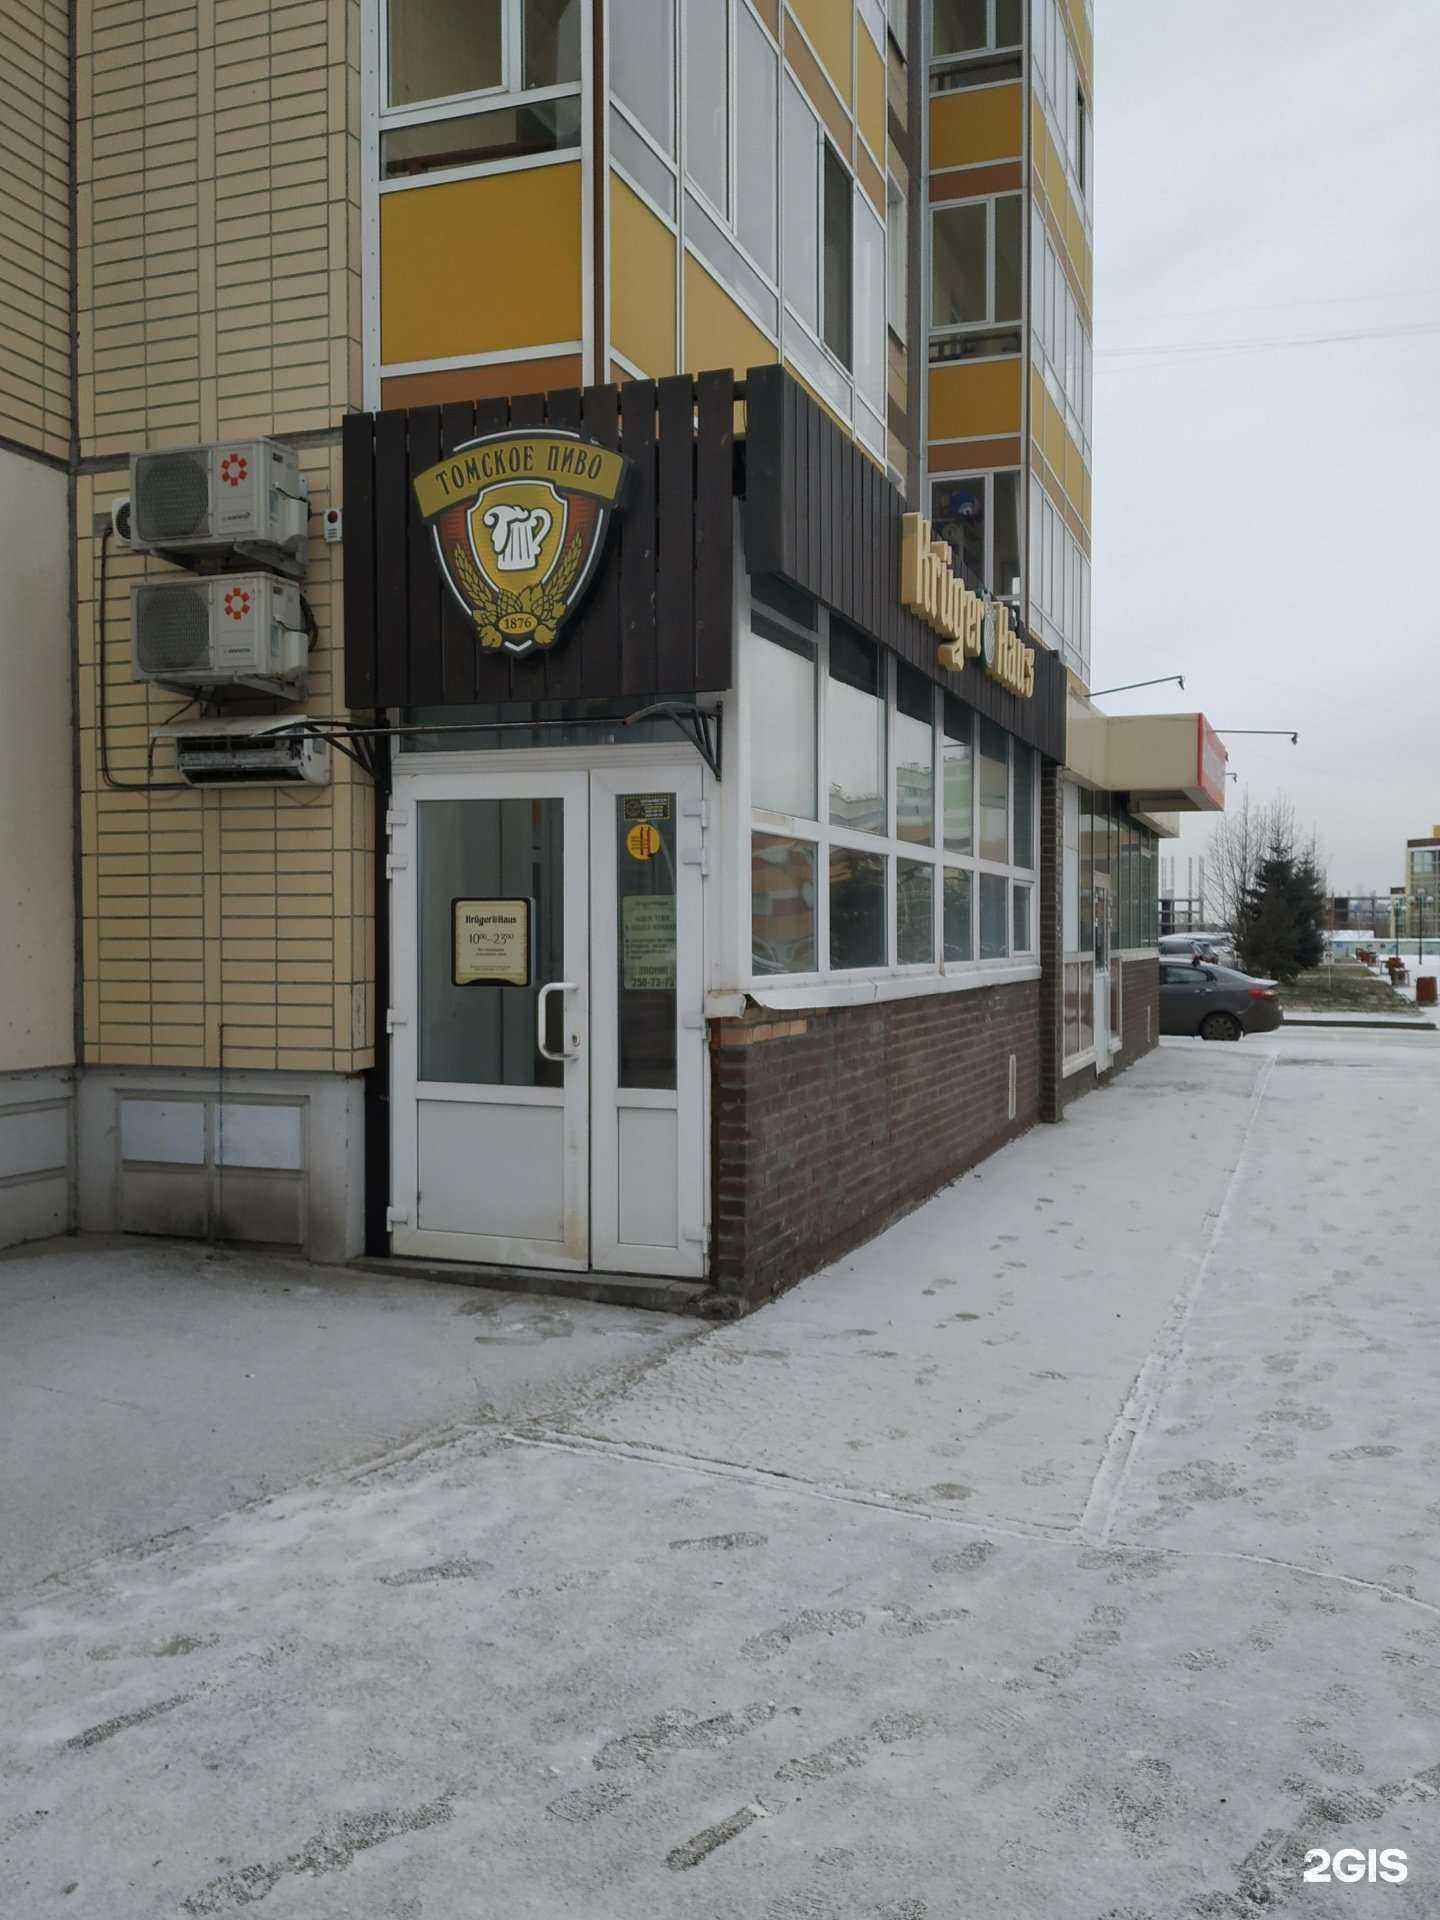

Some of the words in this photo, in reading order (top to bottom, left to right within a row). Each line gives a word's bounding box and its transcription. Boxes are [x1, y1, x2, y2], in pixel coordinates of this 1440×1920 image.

[435, 446, 534, 495] ТОМСКОЕ
[547, 446, 602, 479] ПИВО
[503, 616, 532, 630] 1876
[990, 601, 1035, 698] Haus
